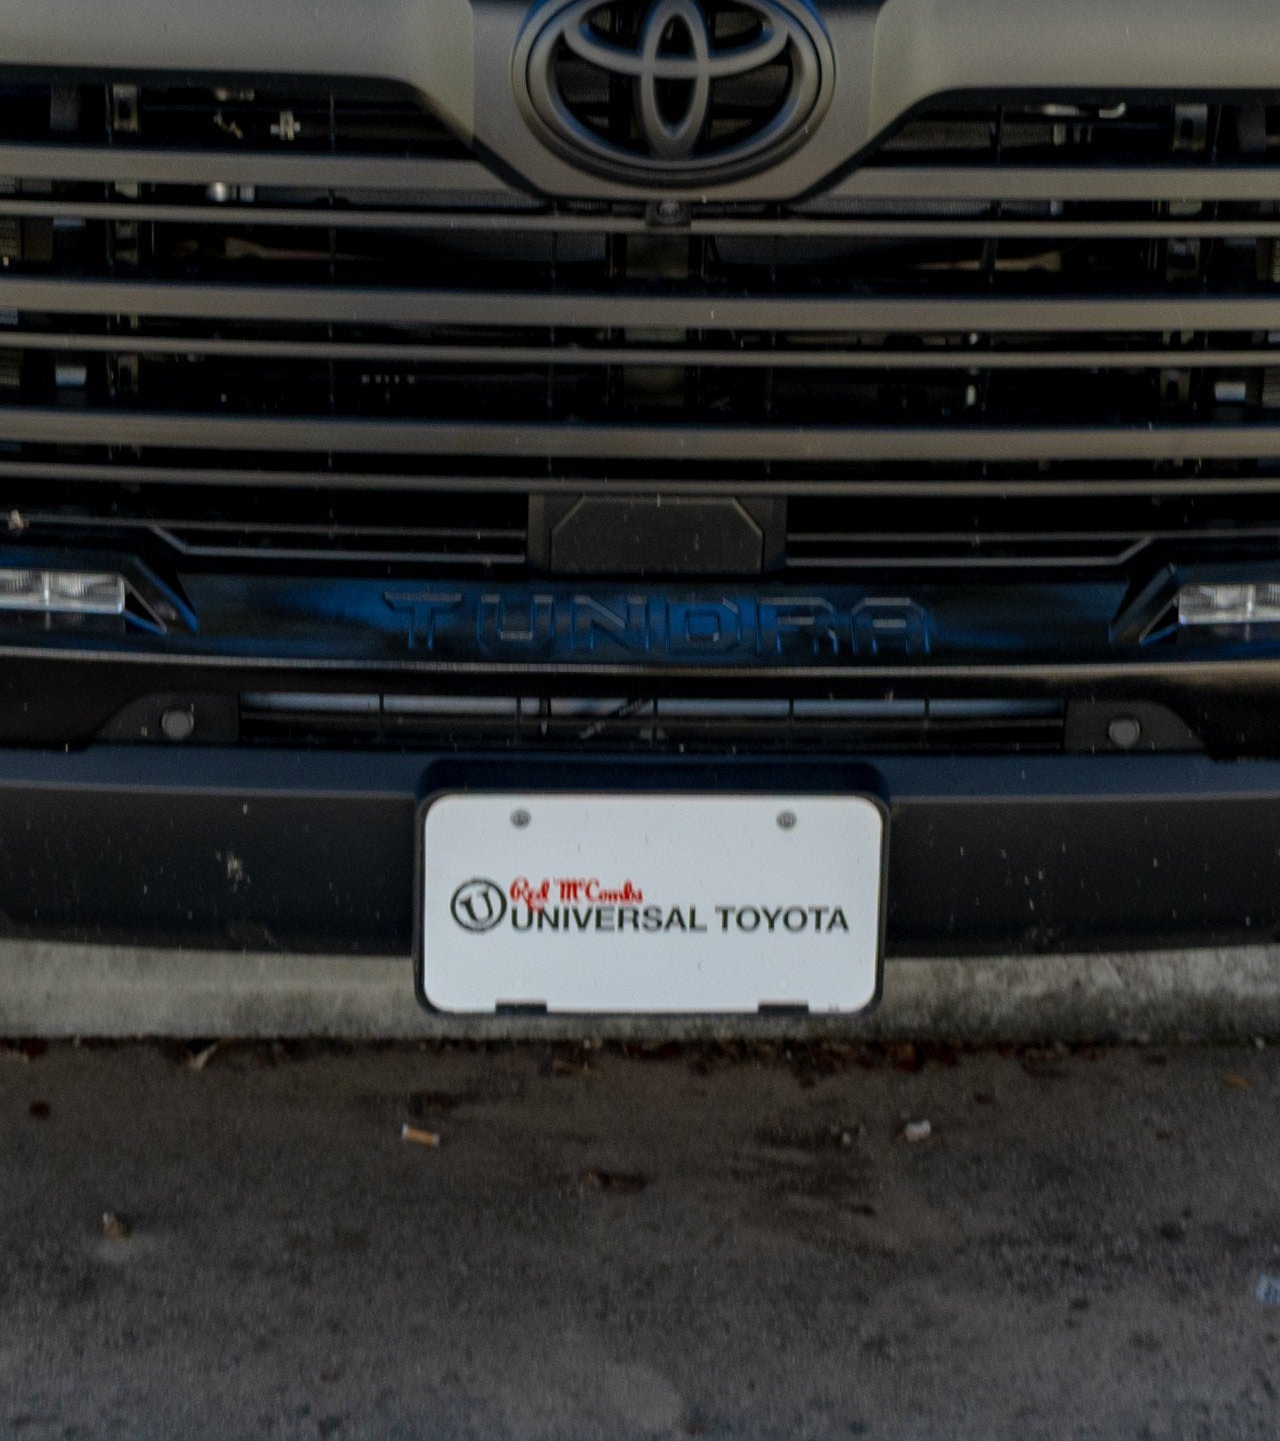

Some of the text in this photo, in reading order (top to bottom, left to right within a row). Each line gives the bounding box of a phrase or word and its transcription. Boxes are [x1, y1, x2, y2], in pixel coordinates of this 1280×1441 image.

[383, 592, 931, 656] TUNDRA
[509, 875, 551, 912] Red
[511, 905, 849, 933] UNIVERSAL TOYOTA
